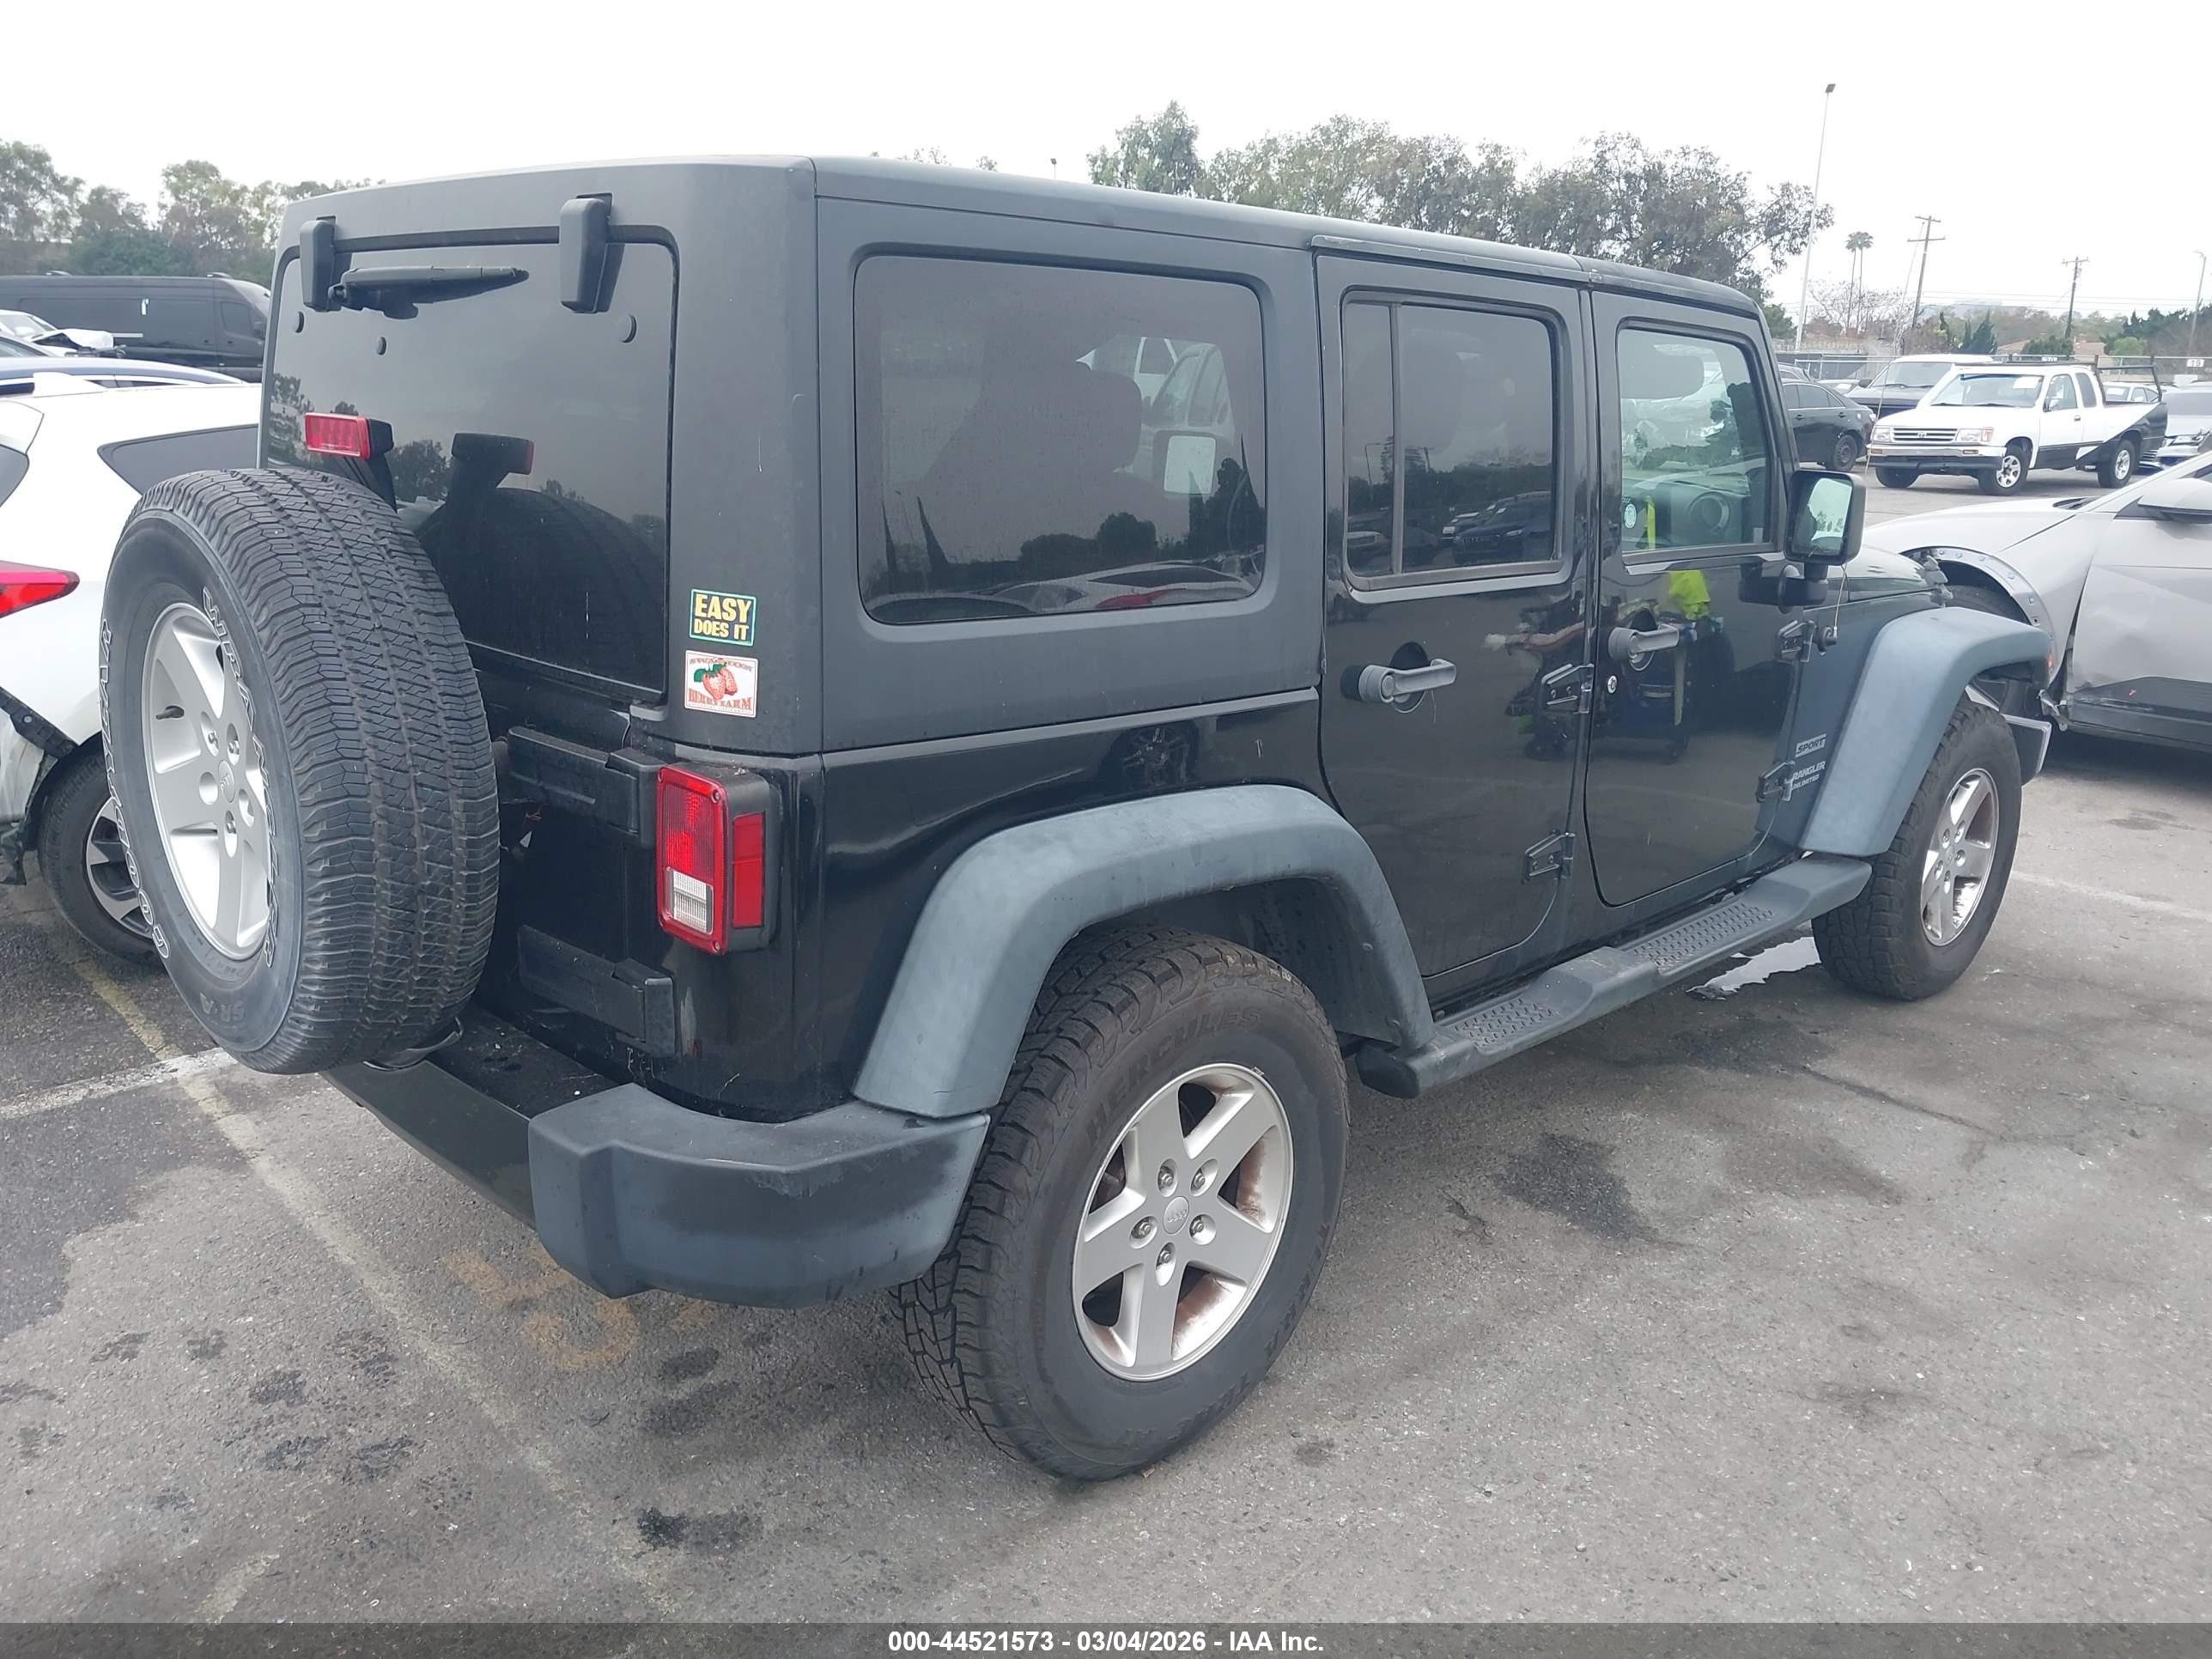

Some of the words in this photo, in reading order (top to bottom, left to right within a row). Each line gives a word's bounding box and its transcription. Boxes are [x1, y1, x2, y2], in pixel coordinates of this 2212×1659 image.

[695, 593, 751, 623] EASY
[694, 618, 729, 638] DOES
[733, 624, 749, 641] IT
[720, 697, 753, 711] FARM
[1797, 738, 1823, 752] SPORT
[1791, 760, 1826, 781] RANGLER
[100, 617, 171, 960] GOODYEAR
[1085, 1006, 1262, 1146] HERCULES
